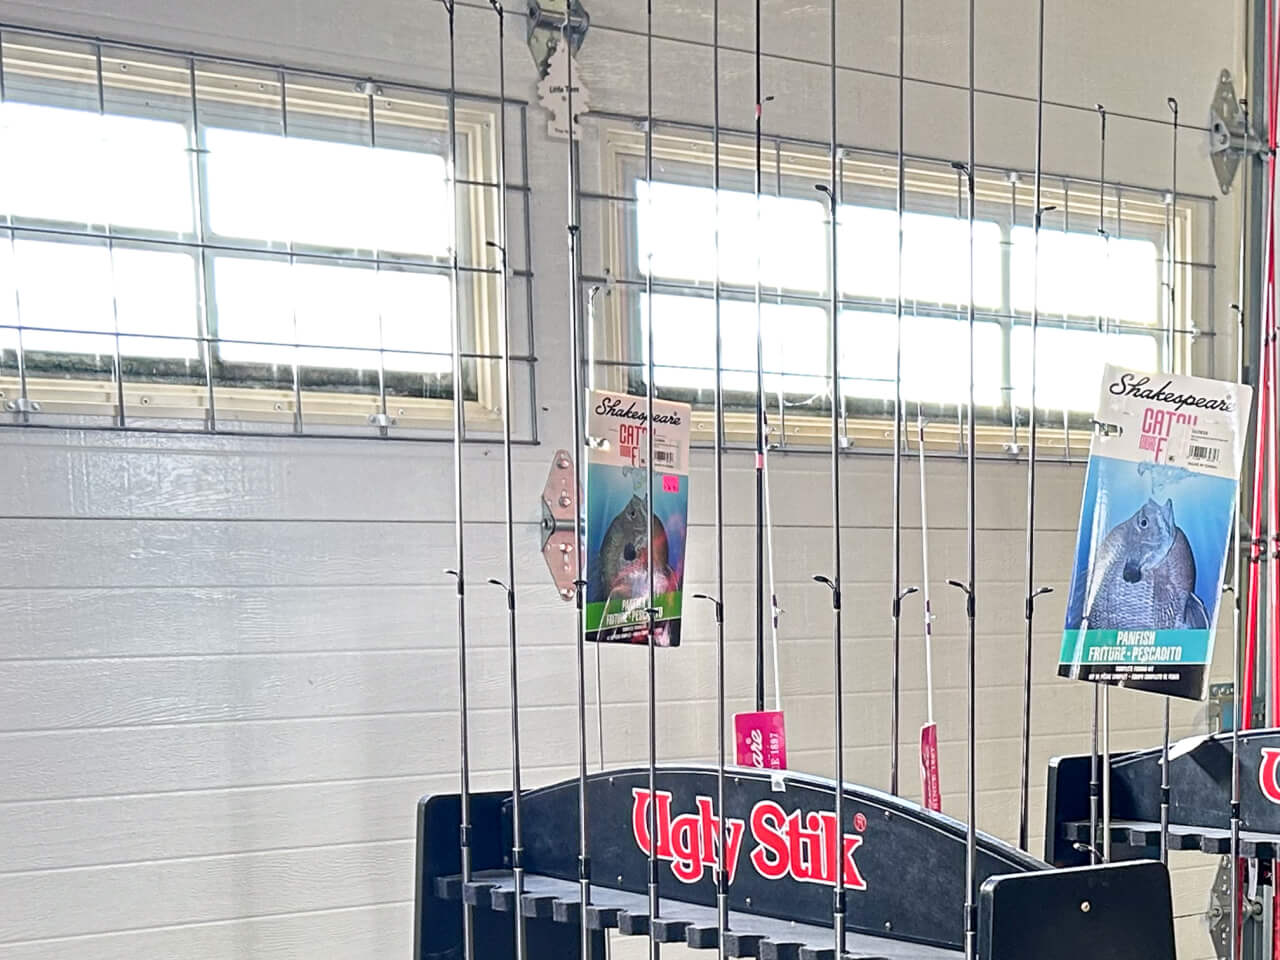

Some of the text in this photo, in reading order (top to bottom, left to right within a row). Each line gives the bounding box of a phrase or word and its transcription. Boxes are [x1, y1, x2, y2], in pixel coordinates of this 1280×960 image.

[1109, 373, 1233, 413] Shakespeare
[1116, 631, 1156, 646] PANFISH
[1088, 646, 1182, 661] FRITURE PESCADITO
[631, 787, 867, 891] Ugly Stik
